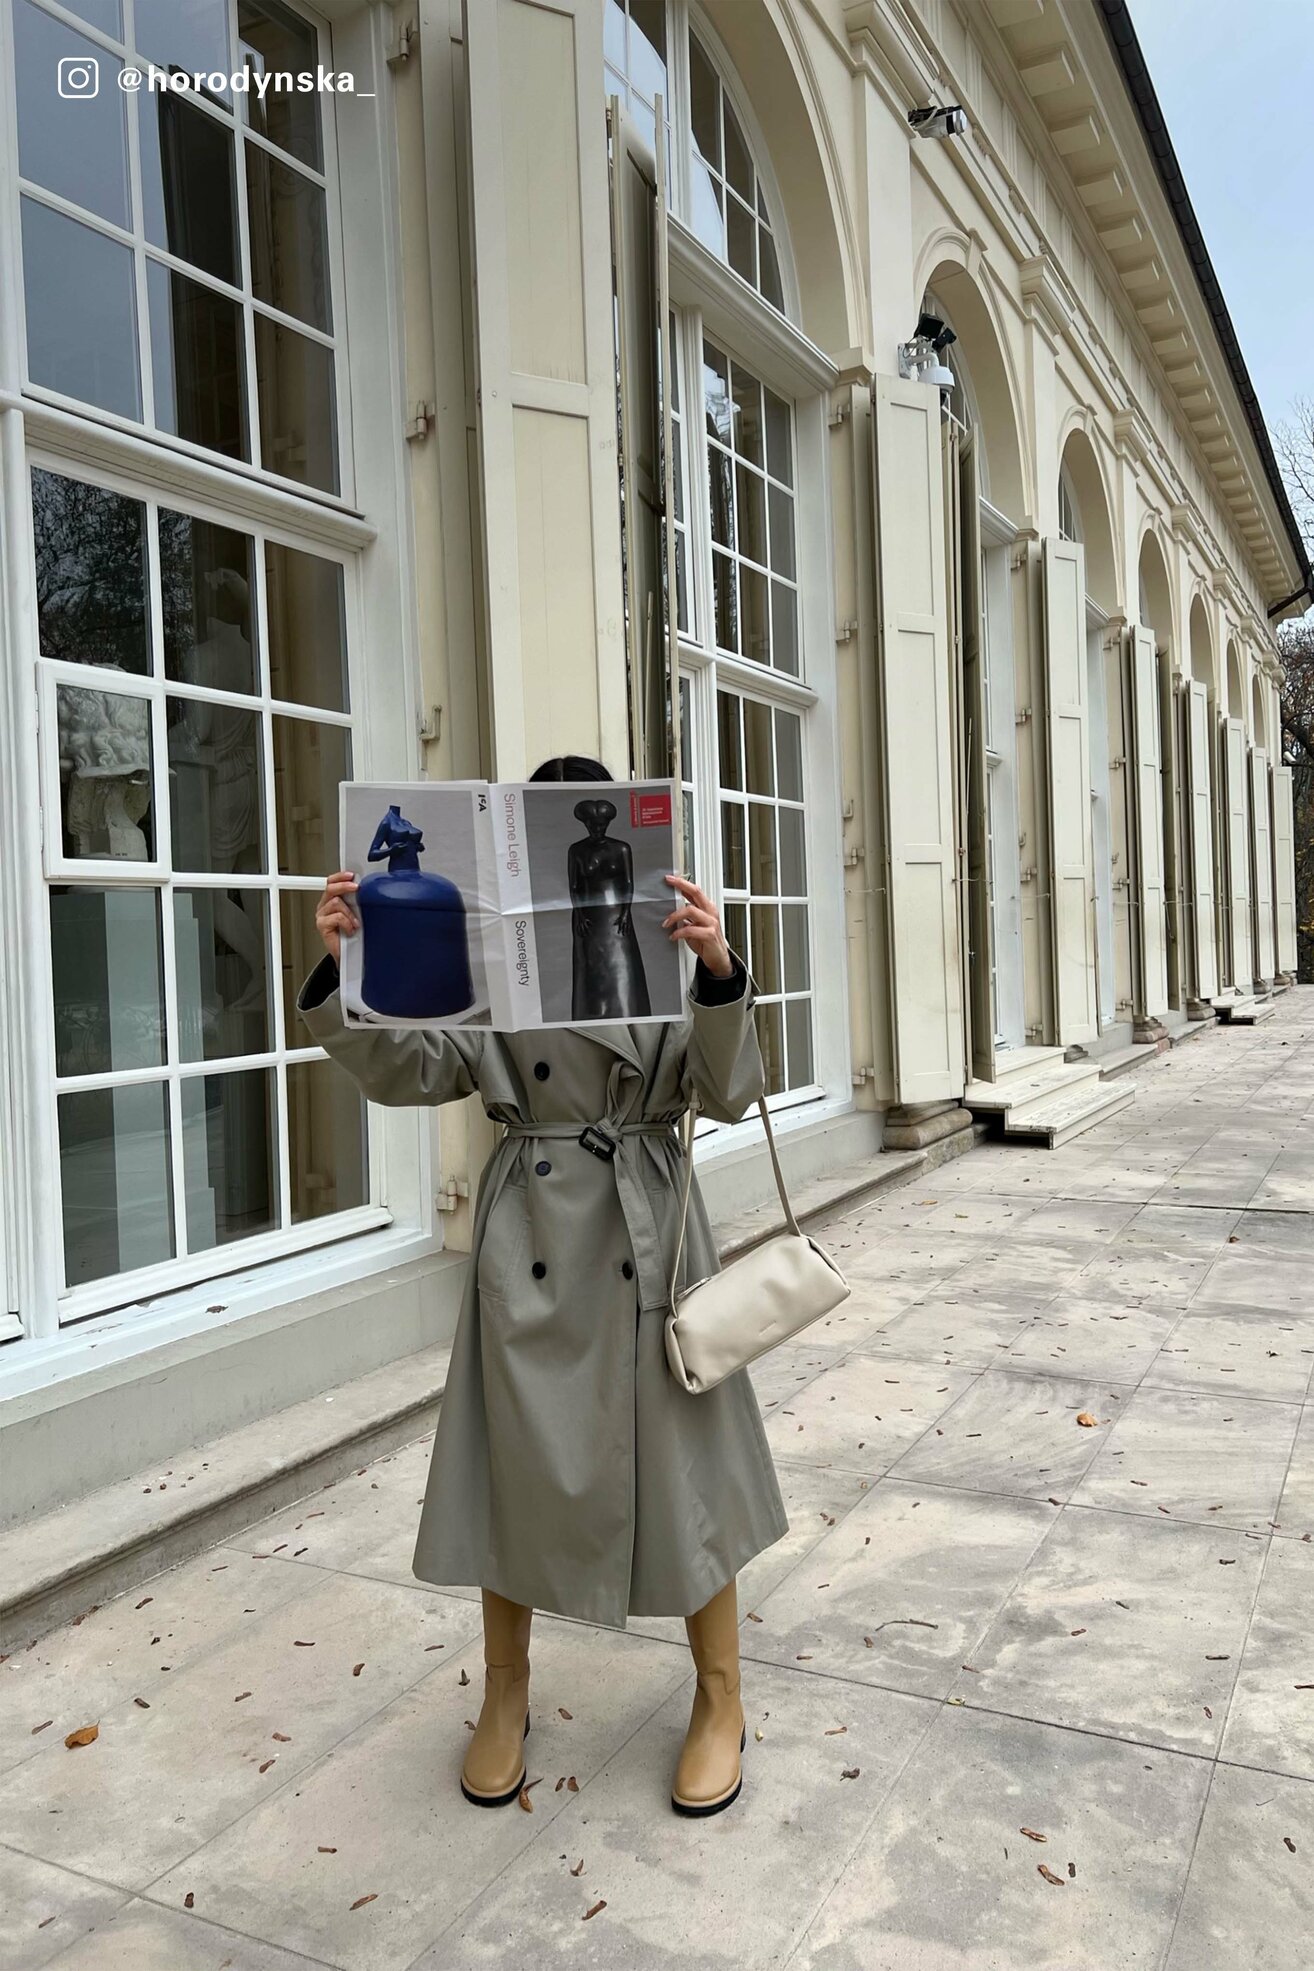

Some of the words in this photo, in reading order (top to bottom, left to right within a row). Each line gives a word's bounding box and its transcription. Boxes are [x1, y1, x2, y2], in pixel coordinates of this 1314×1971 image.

[504, 793, 516, 841] Simone
[506, 843, 521, 877] Leigh
[515, 920, 530, 987] Sovereignty
